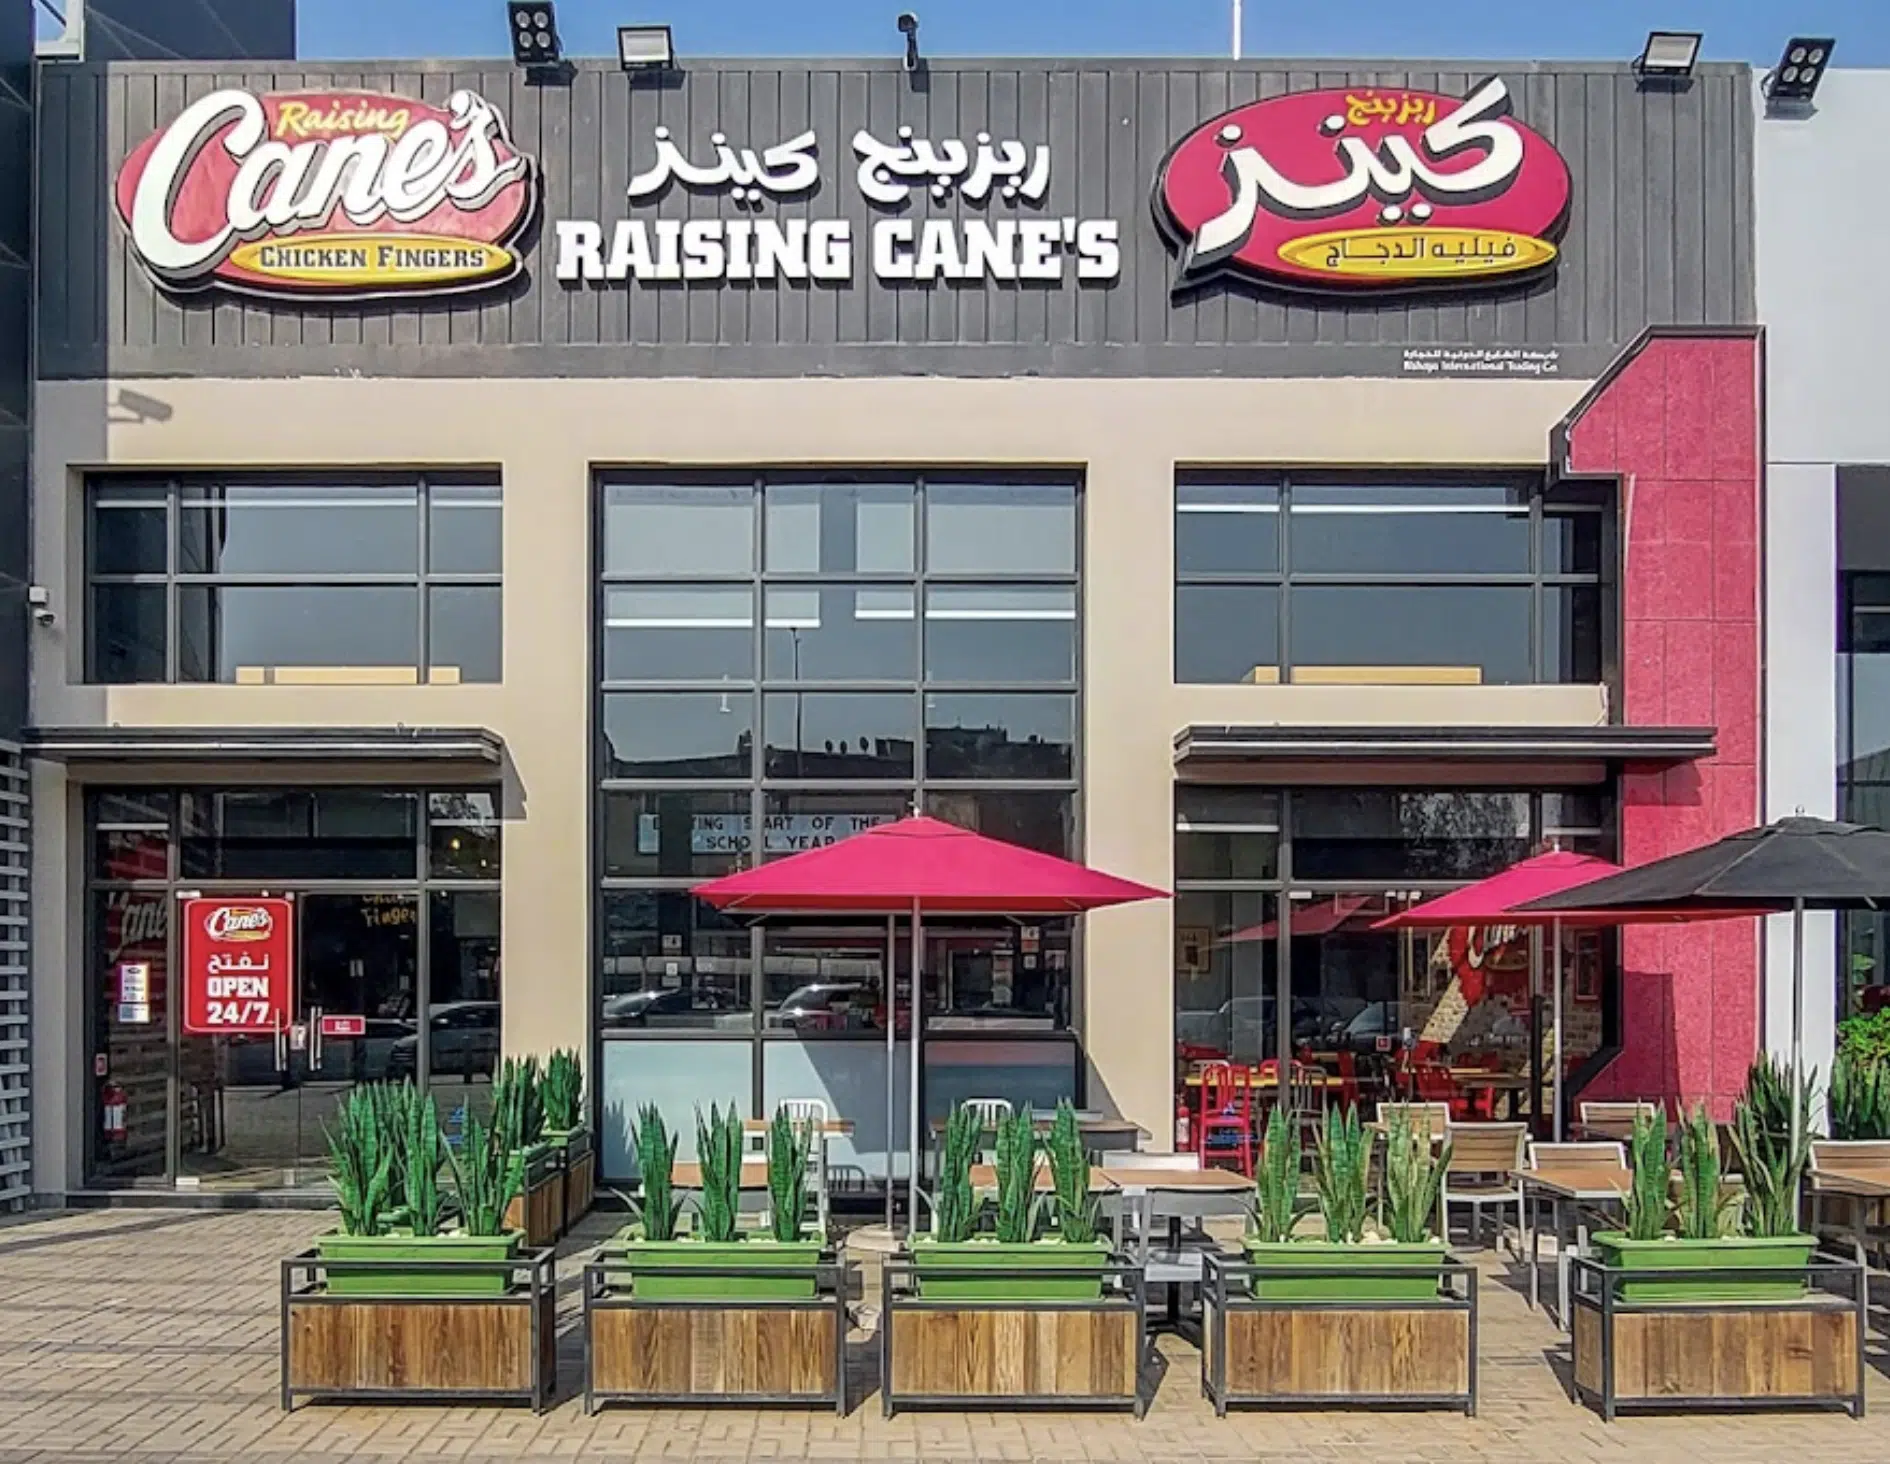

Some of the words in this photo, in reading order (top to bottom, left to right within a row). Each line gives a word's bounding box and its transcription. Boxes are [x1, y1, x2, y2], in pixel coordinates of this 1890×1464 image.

[275, 101, 412, 138] Raising
[1346, 91, 1436, 127] ريزينج
[130, 88, 530, 270] Cane's
[627, 125, 819, 202] كينز
[853, 125, 1050, 203] ريزينج
[1197, 76, 1524, 256] كينز
[555, 219, 853, 281] RAISING
[873, 216, 1120, 281] CANE'S
[1325, 237, 1425, 267] الدجاج
[1430, 236, 1517, 263] فيليه
[743, 816, 795, 831] SART
[812, 816, 834, 831] OF
[706, 835, 774, 850] SCHOL
[207, 976, 269, 998] OPEN
[207, 1001, 269, 1024] 24/7
